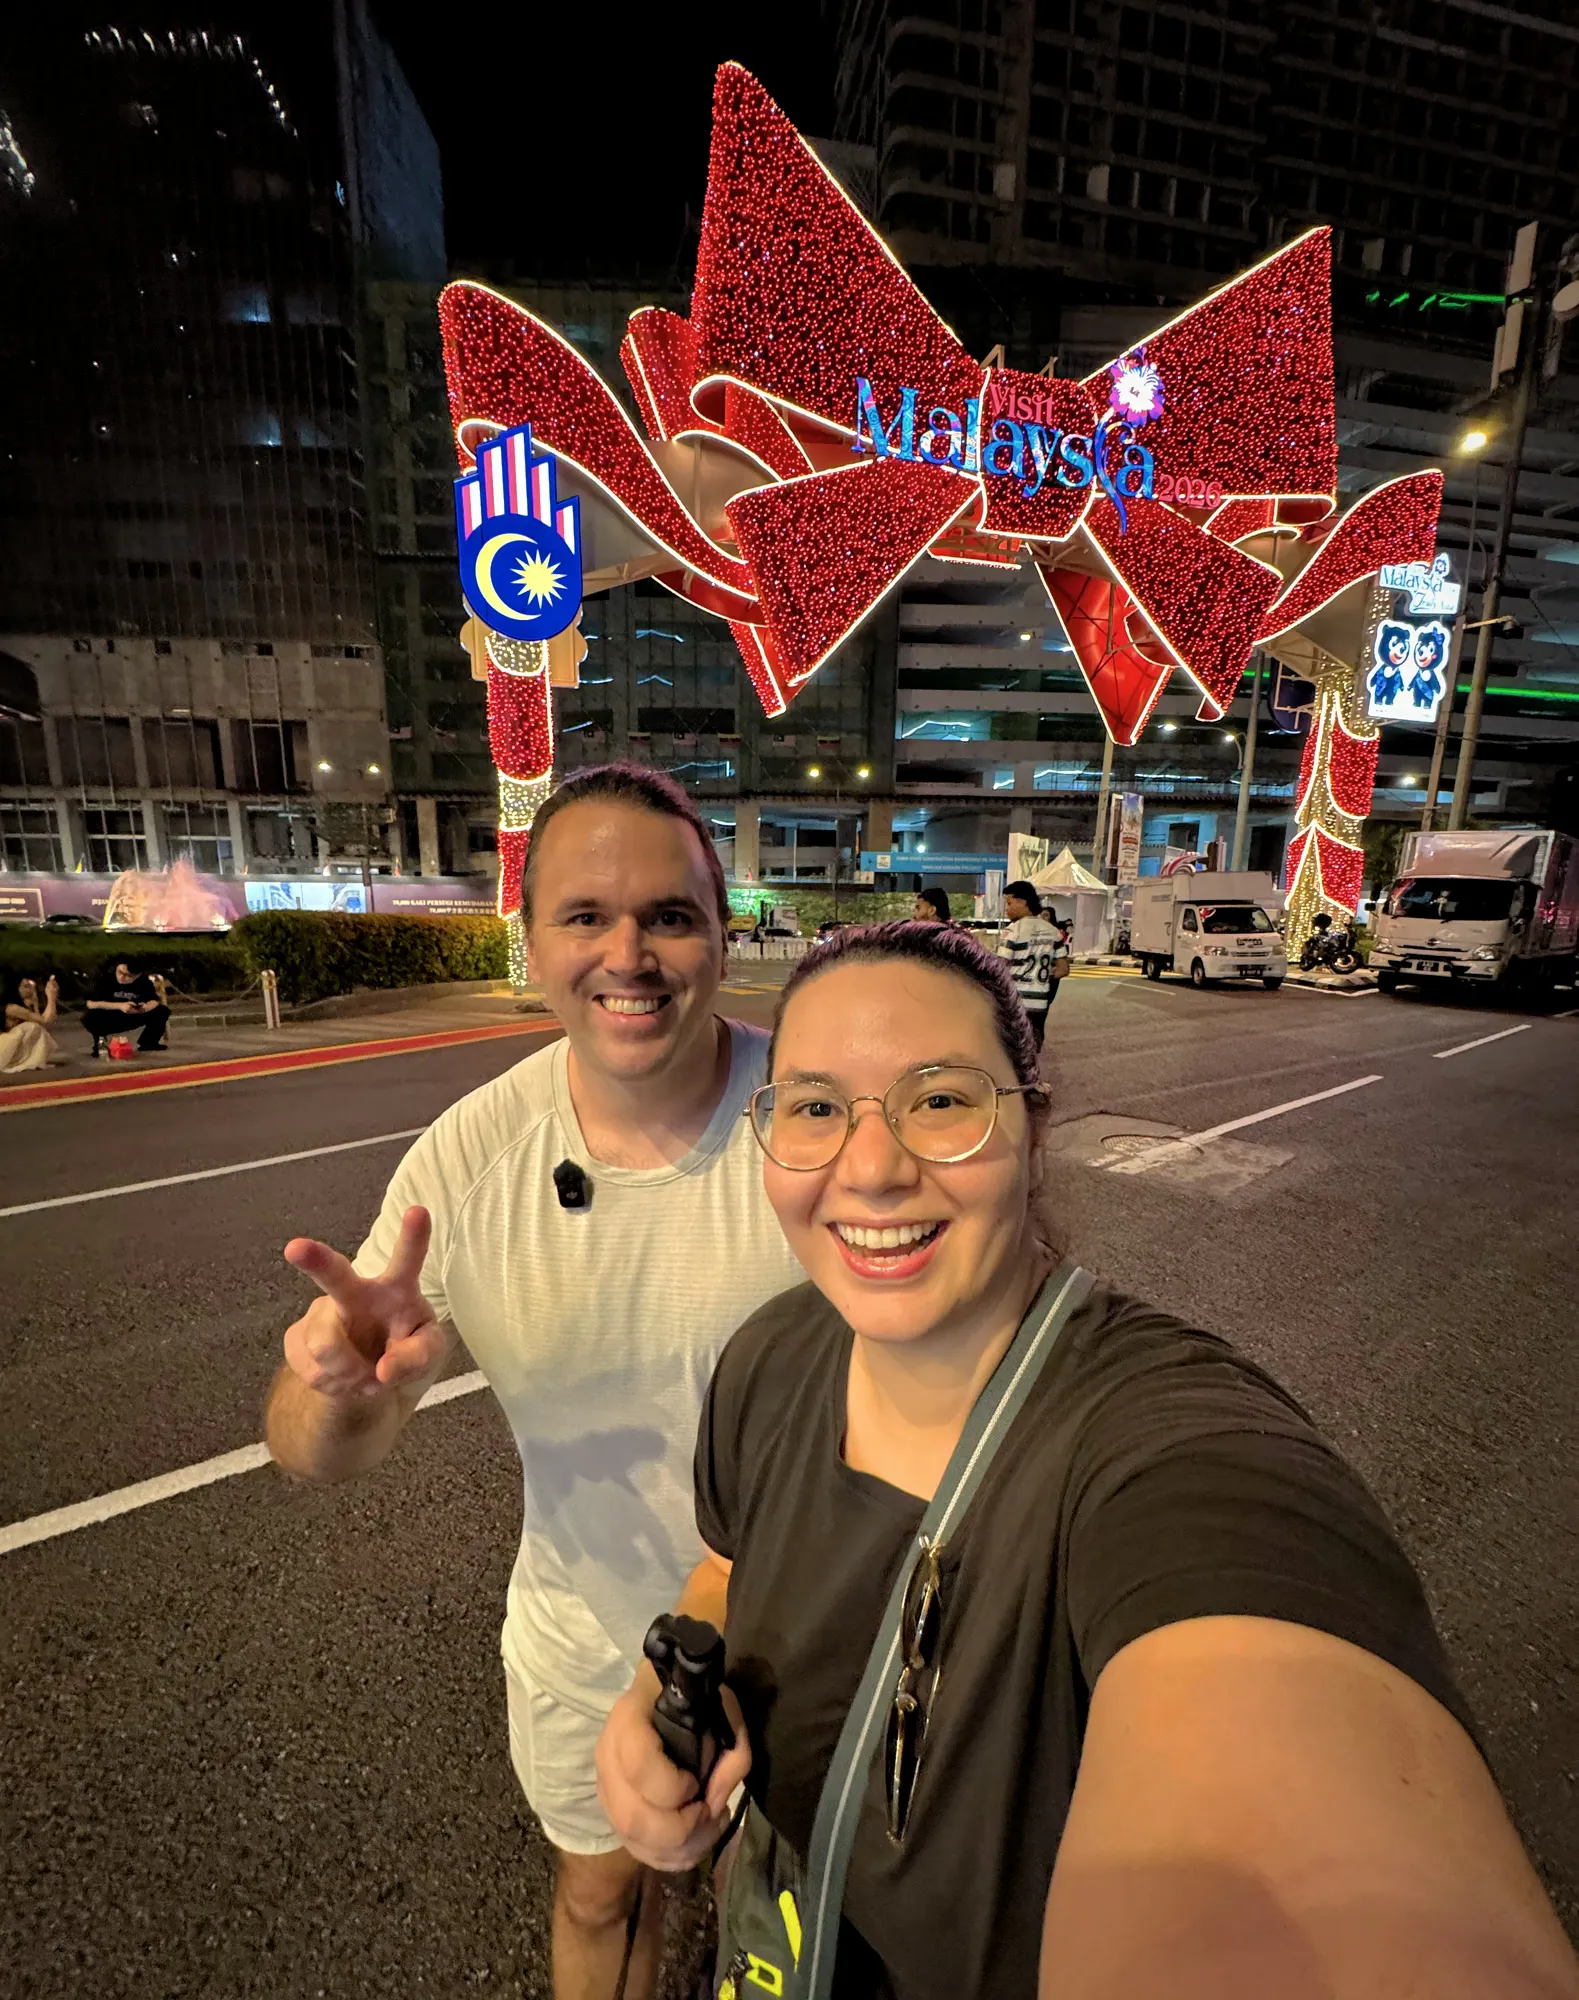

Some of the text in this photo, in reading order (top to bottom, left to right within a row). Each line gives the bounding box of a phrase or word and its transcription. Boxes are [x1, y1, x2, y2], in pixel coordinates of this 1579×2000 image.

[990, 384, 1054, 425] Visit
[851, 376, 1155, 536] Malaysia
[1158, 473, 1223, 509] 2026
[1018, 954, 1050, 982] 28
